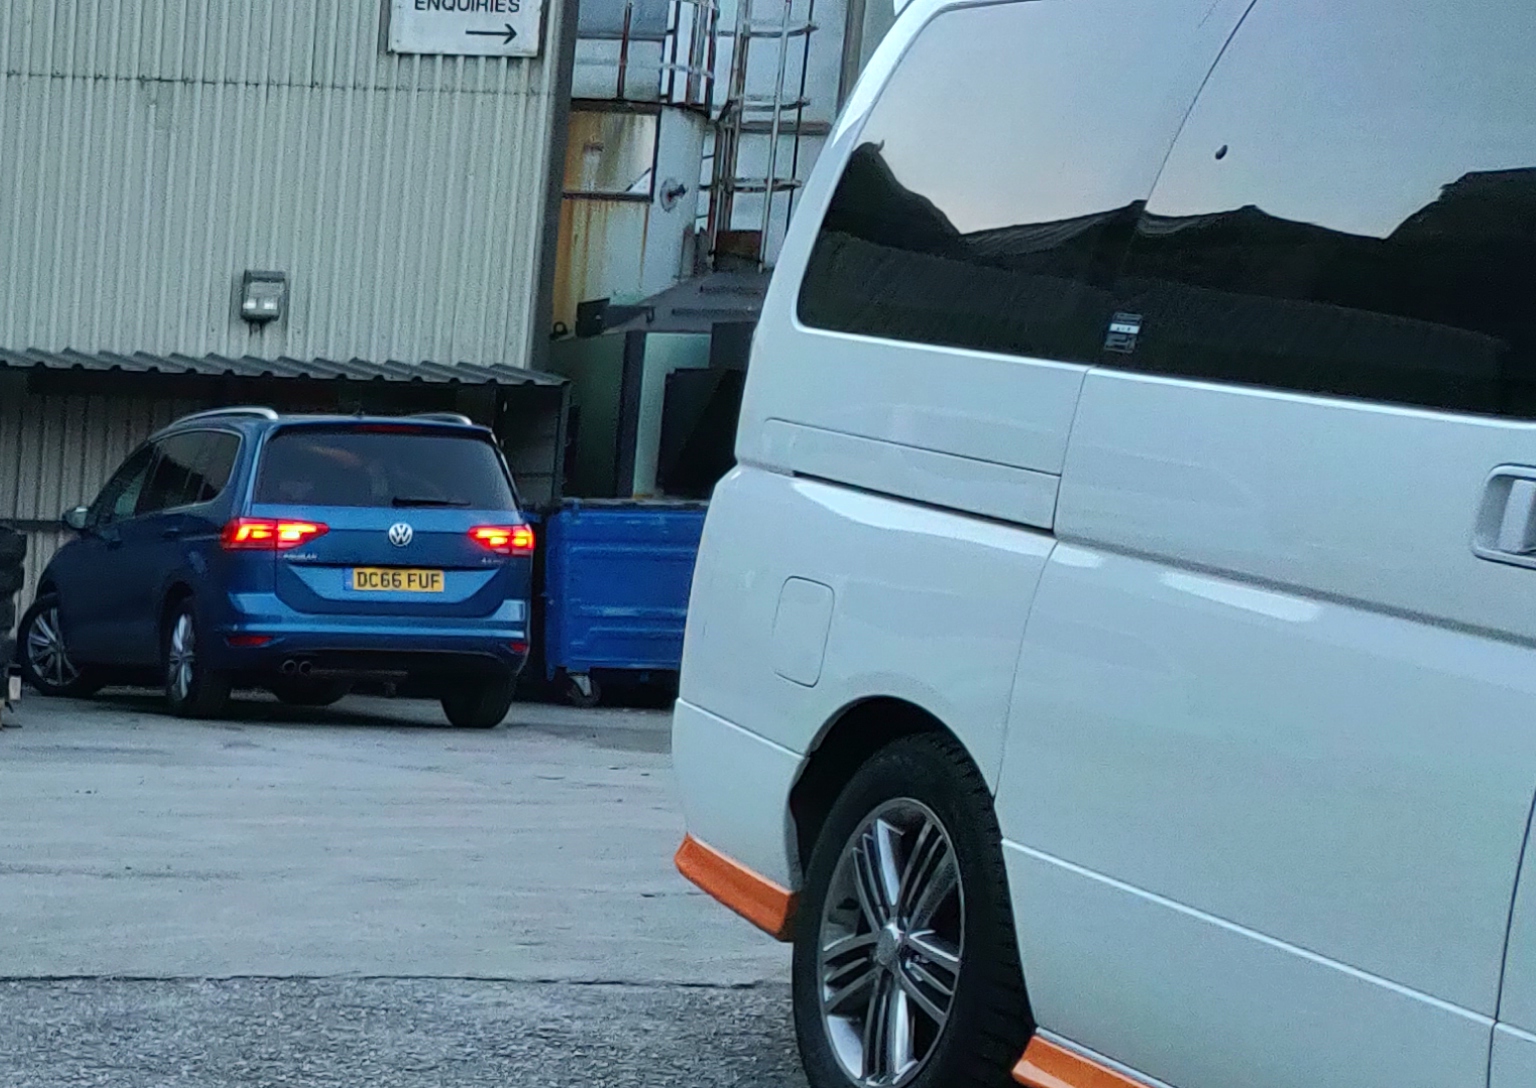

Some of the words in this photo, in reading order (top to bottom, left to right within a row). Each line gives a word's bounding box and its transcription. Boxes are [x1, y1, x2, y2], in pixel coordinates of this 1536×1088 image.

[414, 0, 521, 13] ENQUIRIES
[356, 571, 402, 588] DC66
[407, 573, 441, 590] FUF
